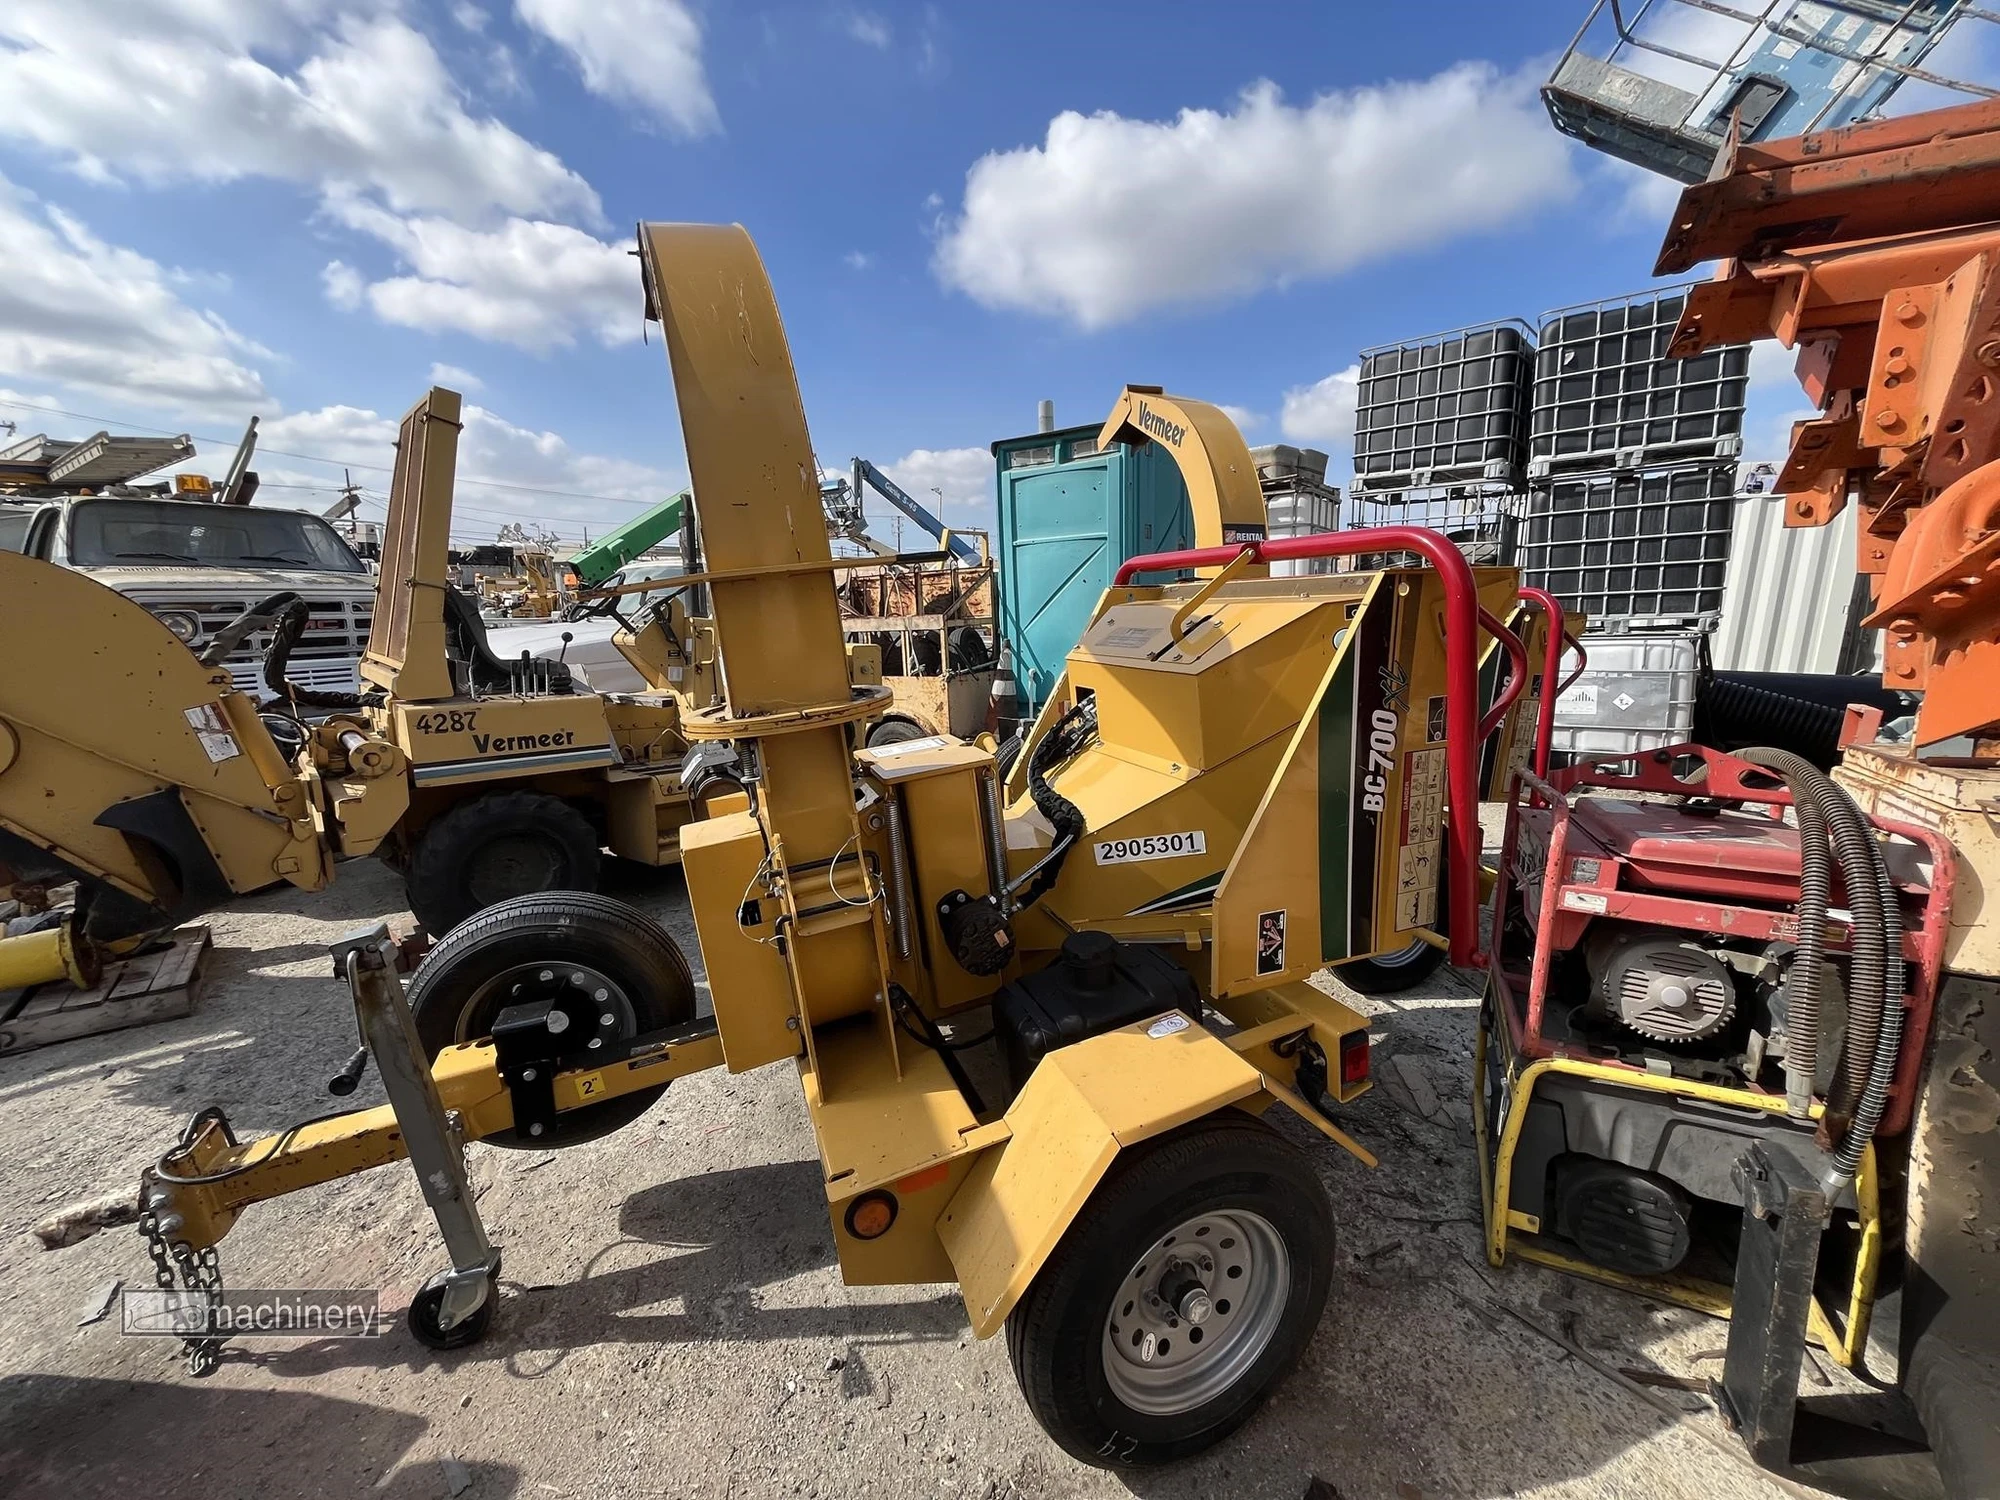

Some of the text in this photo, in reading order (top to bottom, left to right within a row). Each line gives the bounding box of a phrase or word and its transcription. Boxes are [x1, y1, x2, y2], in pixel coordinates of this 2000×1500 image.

[1138, 400, 1185, 448] Vermeer
[901, 496, 918, 512] S-45
[1236, 532, 1264, 542] RENTAL
[415, 709, 478, 735] 4287
[472, 730, 574, 754] Vermeer
[1362, 660, 1411, 812] BC700 XL
[1100, 832, 1196, 860] 2905301
